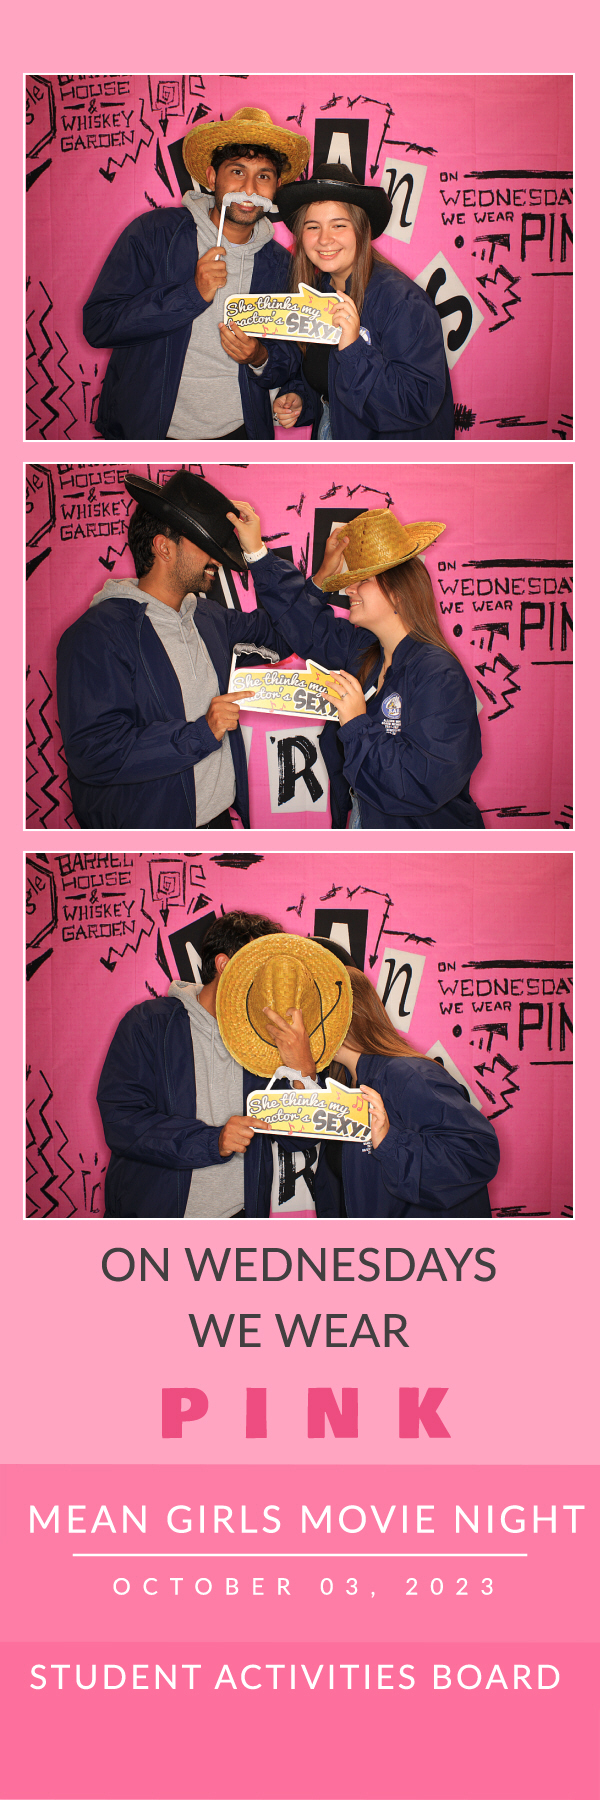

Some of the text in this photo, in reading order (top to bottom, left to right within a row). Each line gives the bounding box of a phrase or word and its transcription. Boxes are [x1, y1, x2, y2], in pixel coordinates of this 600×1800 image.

[60, 81, 131, 101] HOUSE
[88, 98, 98, 114] &
[61, 110, 134, 131] WHISKEY
[60, 130, 135, 152] GARDEN
[440, 171, 458, 182] ON
[441, 212, 466, 225] WE
[474, 211, 514, 223] WEAR
[226, 295, 322, 320] She thinks my
[60, 469, 130, 490] HOUSE
[87, 487, 97, 503] &
[60, 499, 133, 520] WHISKEY
[438, 561, 456, 571] ON
[440, 602, 464, 614] WE
[472, 600, 513, 612] WEAR
[233, 671, 328, 698] She thinks my
[61, 871, 131, 891] HOUSE
[89, 888, 99, 904] &
[62, 900, 135, 921] WHISKEY
[62, 920, 135, 942] GARDEN
[438, 961, 456, 972] ON
[440, 1002, 463, 1015] WE
[472, 1001, 511, 1013] WEAR
[249, 1092, 350, 1118] She thinks my
[251, 1108, 372, 1141] actor's SEXY!
